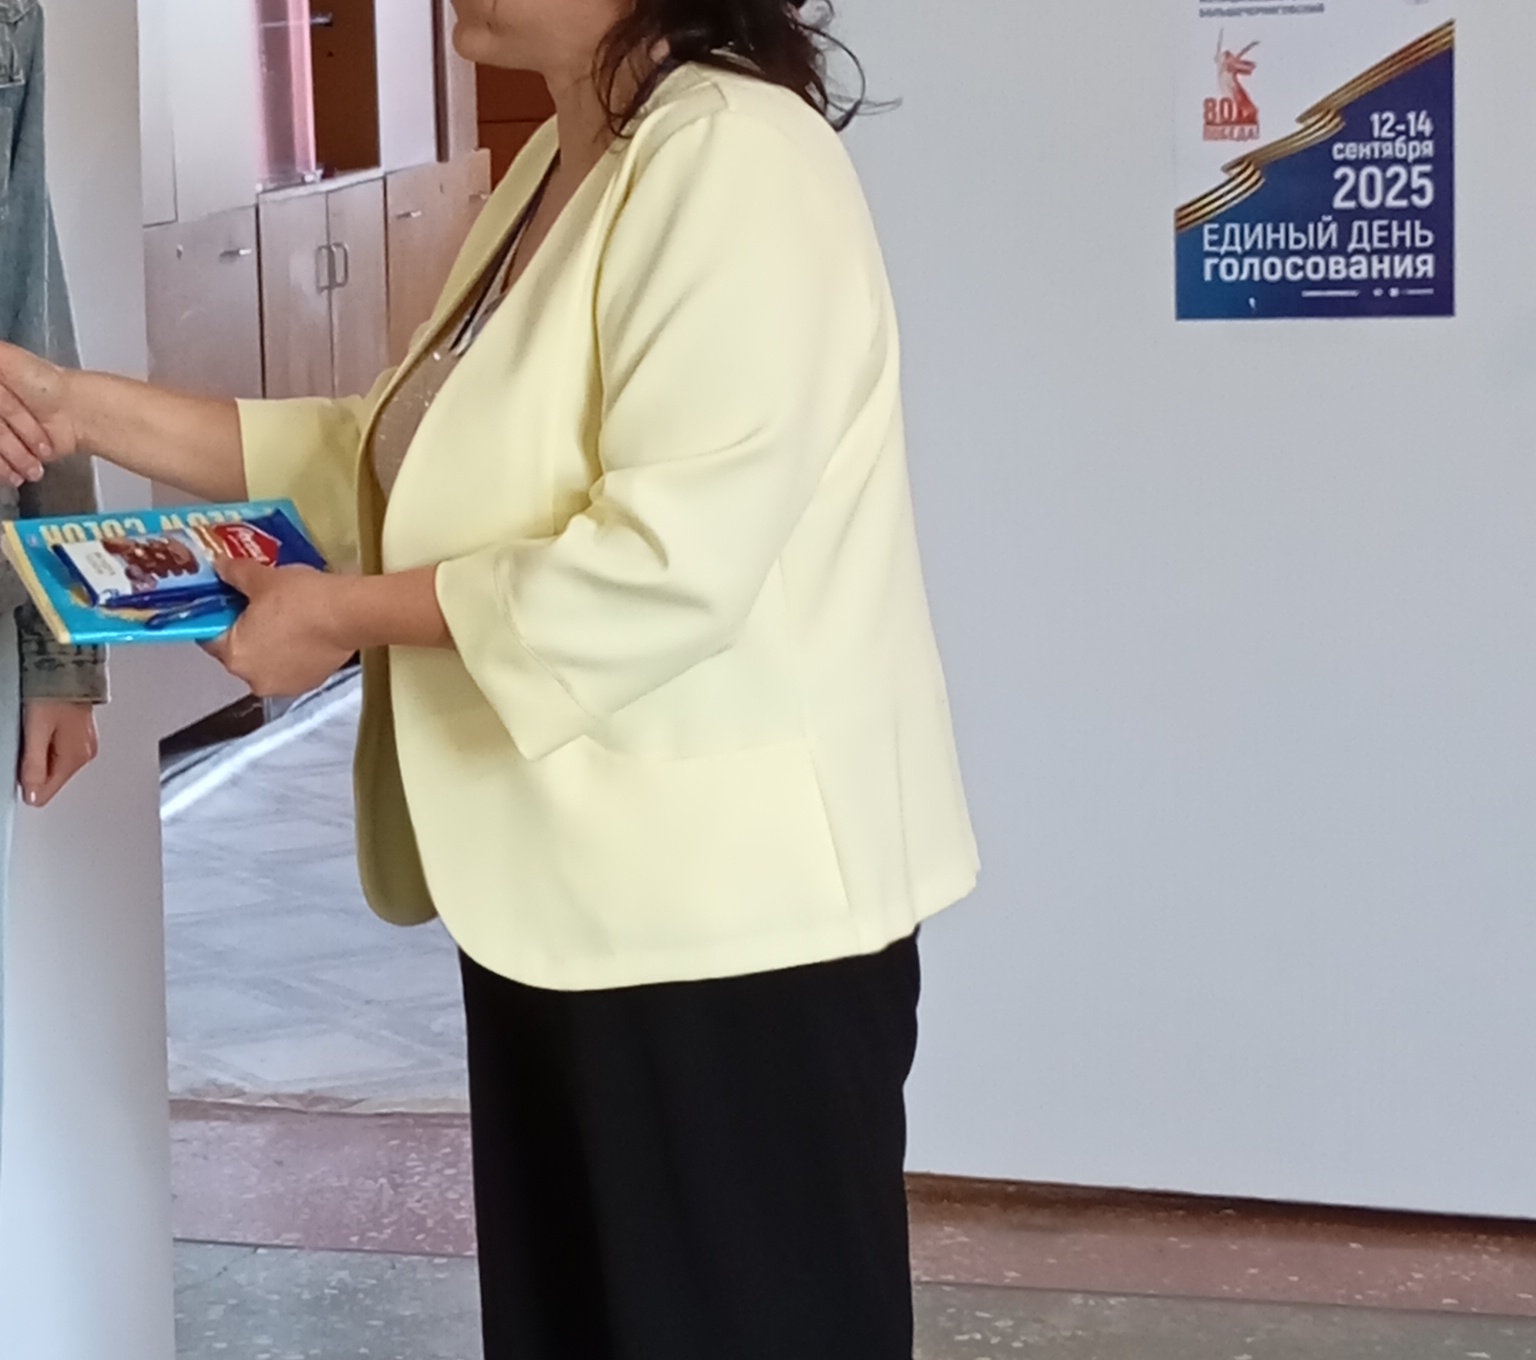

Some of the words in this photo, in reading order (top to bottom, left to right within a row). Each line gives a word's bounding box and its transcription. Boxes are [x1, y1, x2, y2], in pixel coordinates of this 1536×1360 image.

[1370, 110, 1433, 138] 12-14
[1332, 136, 1434, 162] сентября
[1332, 164, 1434, 209] 2025
[1202, 215, 1339, 255] ЕДИНЫЙ
[1347, 219, 1435, 252] ДЕНЬ
